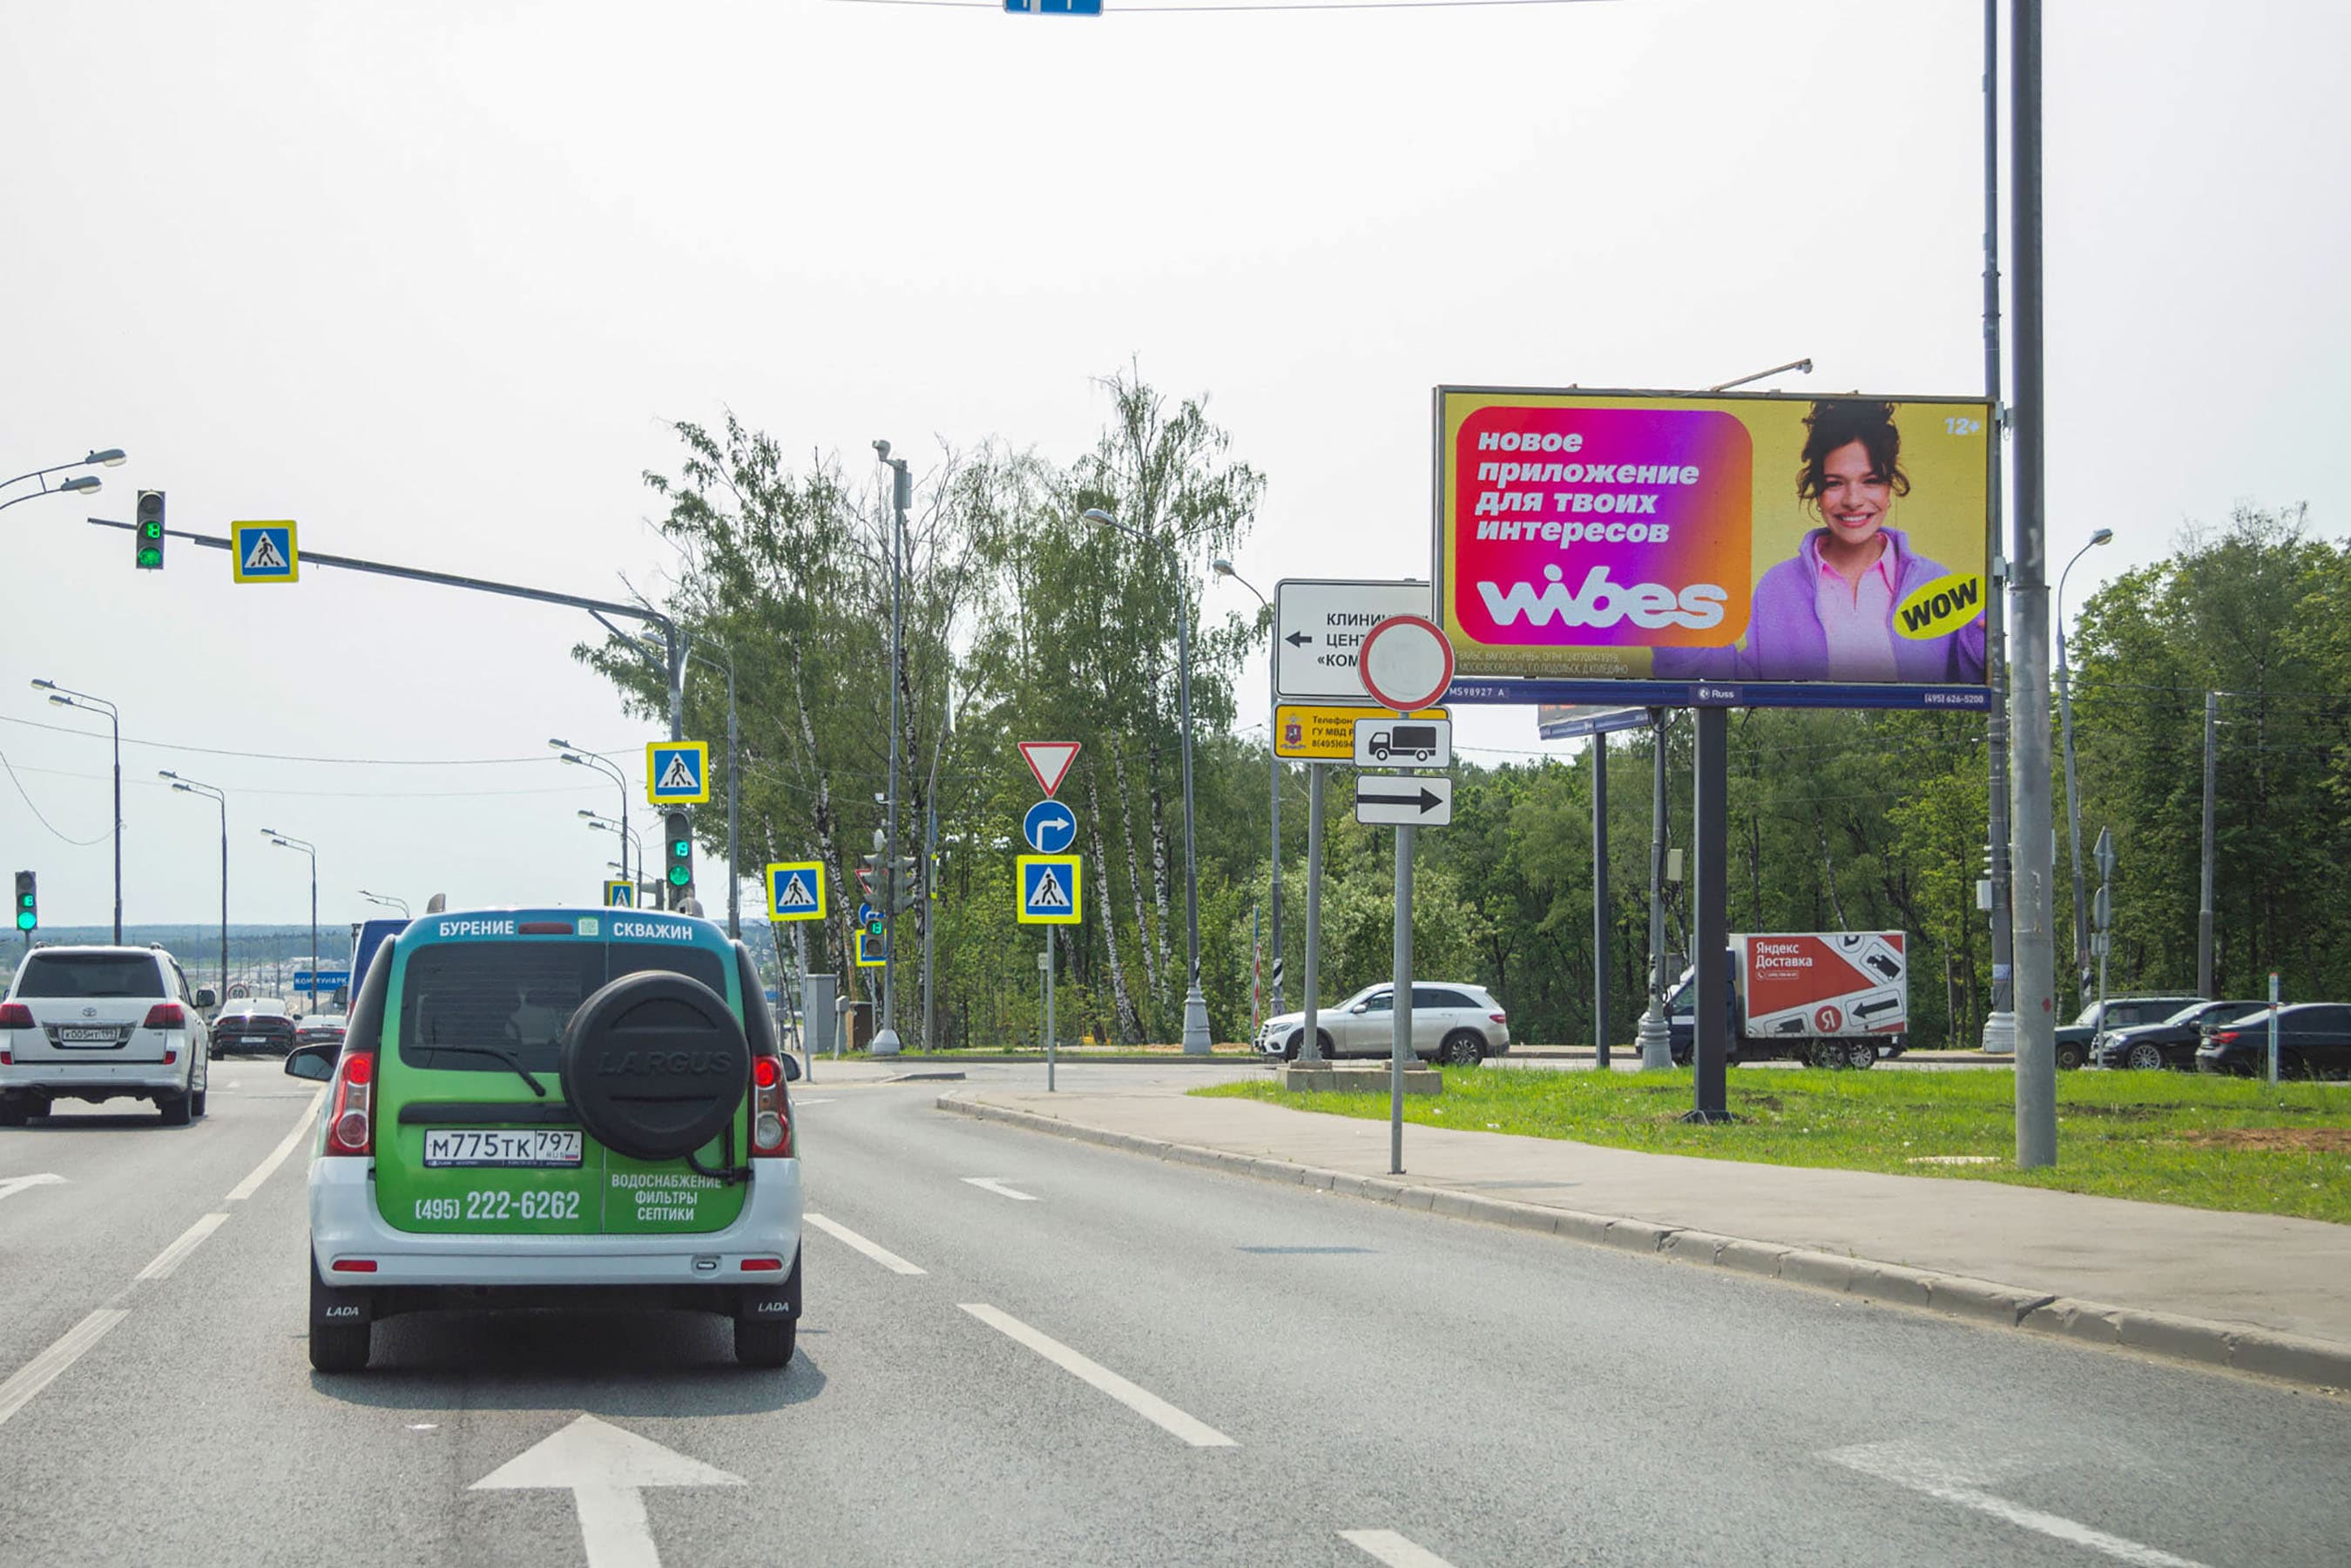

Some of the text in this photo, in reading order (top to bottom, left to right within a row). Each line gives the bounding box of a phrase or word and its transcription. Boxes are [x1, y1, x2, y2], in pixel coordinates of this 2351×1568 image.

[1944, 417, 1980, 435] 12+
[1478, 432, 1583, 452] новое
[1477, 463, 1700, 489] приложение
[1475, 491, 1659, 516] для твоих
[1476, 520, 1670, 550] интересов
[1476, 564, 1728, 630] wibes
[1901, 578, 1977, 632] WOW
[1712, 689, 1734, 699] Russ
[1946, 694, 1984, 704] 626-5200
[1313, 715, 1353, 726] Телефон
[1312, 727, 1323, 736] ГУ
[1326, 727, 1347, 738] МВД
[440, 921, 693, 941] БУРЕНИЕ СКВАЖИН
[1756, 942, 1799, 955] Яндекс
[1756, 955, 1813, 970] Доставка
[233, 989, 244, 998] 60
[598, 1051, 732, 1074] LARGUS
[537, 1132, 575, 1151] 797
[611, 1174, 722, 1189] ВОДОСНАБЖЕНИЕ
[415, 1190, 580, 1220] (495) 222-6262
[635, 1191, 698, 1205] ФИЛЬТРЫ
[637, 1206, 694, 1220] СЕПТИКИ
[326, 1306, 359, 1316] LADA
[758, 1301, 789, 1312] LADA
